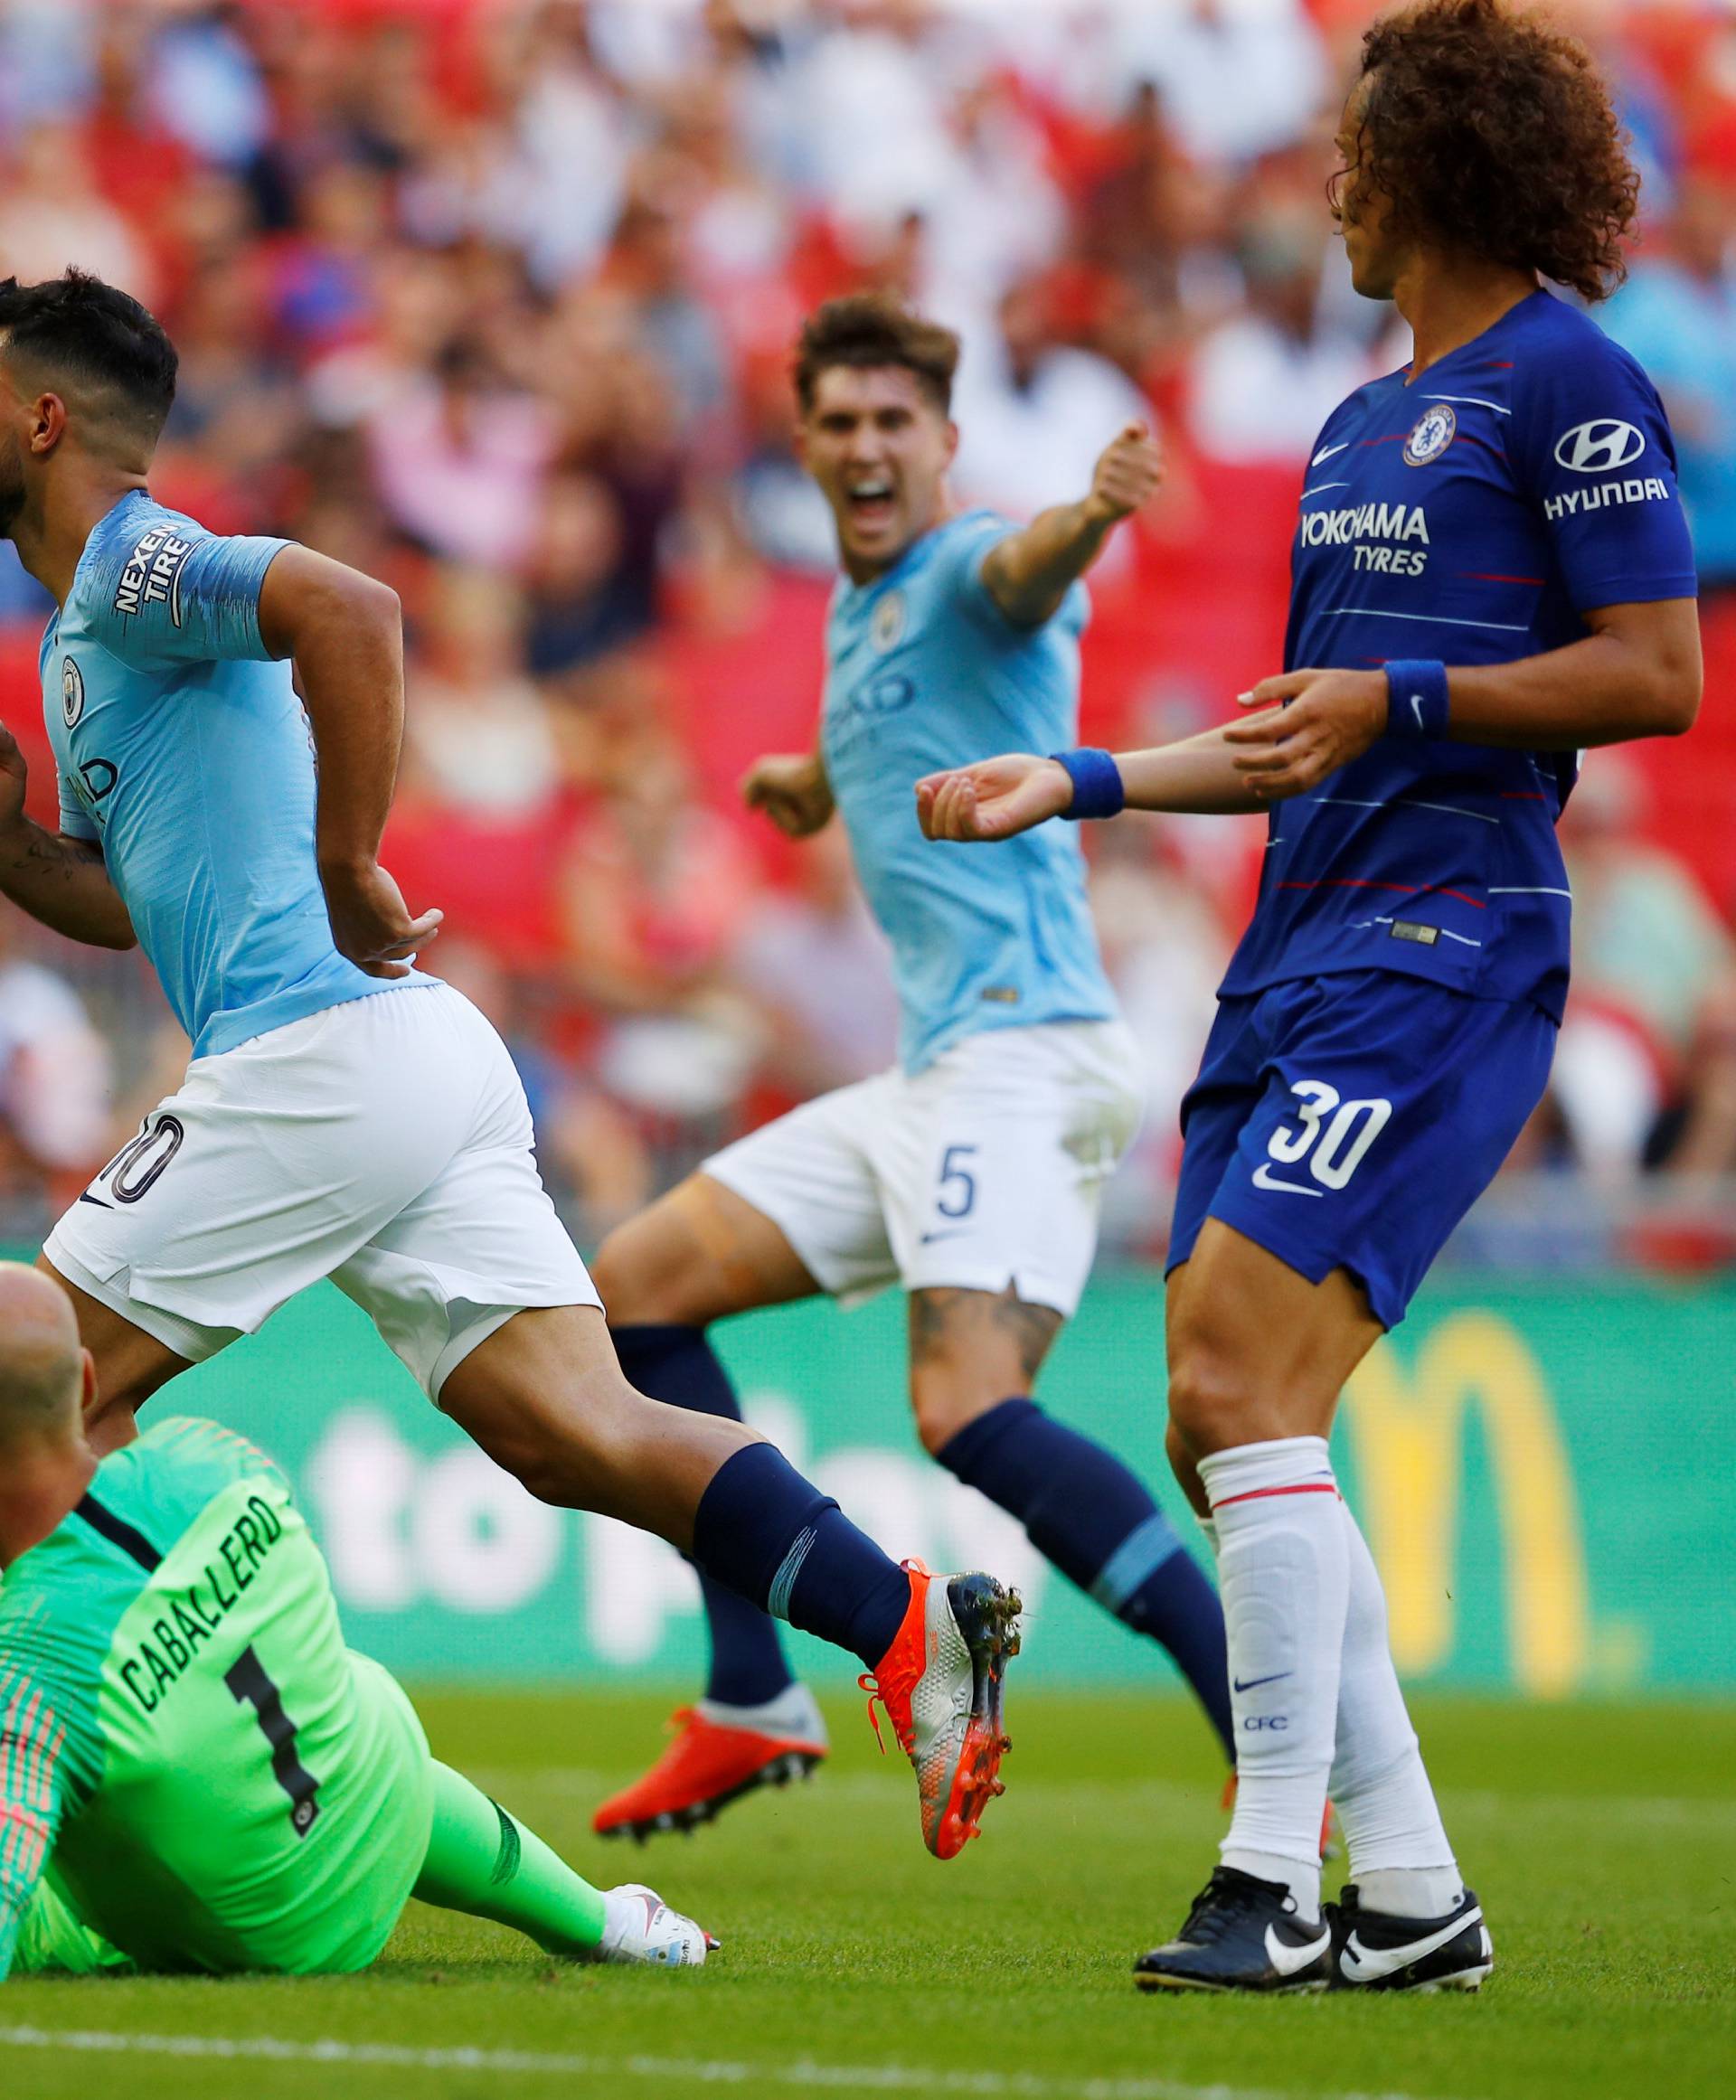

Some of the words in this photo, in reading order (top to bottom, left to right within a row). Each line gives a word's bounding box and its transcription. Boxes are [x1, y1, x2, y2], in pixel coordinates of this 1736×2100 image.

[1301, 503, 1430, 548] YOKOHAMA
[1543, 477, 1669, 521] HYUNDAI
[115, 523, 180, 615] NEXEN
[143, 535, 192, 603] TIRE
[1354, 545, 1428, 577] TYRES
[1268, 1079, 1392, 1190] 30
[937, 1144, 977, 1218] 5
[120, 1496, 282, 1712] CABALLERO
[222, 1643, 320, 1838] 1
[1244, 1716, 1288, 1731] CFC
